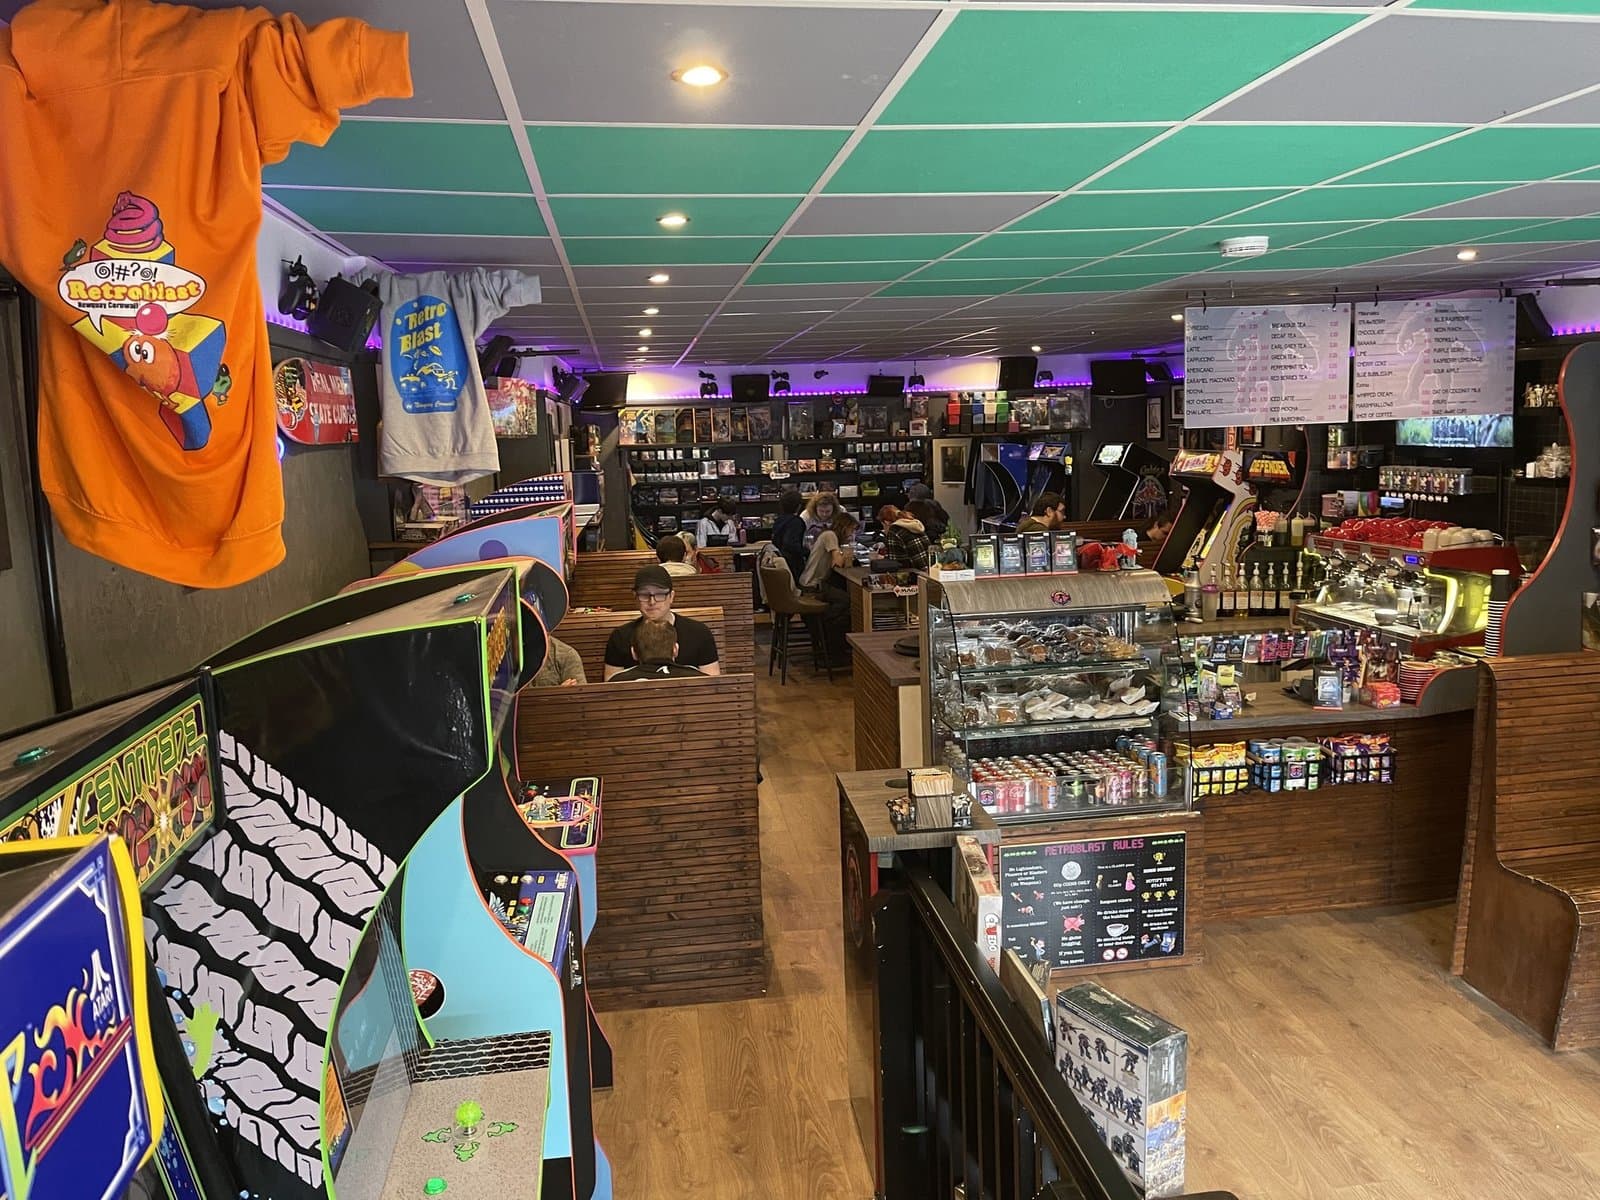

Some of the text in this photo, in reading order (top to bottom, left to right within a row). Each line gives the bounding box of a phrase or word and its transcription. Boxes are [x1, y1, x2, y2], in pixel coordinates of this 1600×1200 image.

[66, 280, 202, 301] Retroblast
[404, 302, 448, 330] Retro
[398, 321, 444, 356] Blast
[1248, 459, 1291, 476] DEFENDER
[79, 708, 207, 834] CENTIPEDE
[1045, 839, 1144, 857] RETROBLAST RULES
[92, 984, 115, 1021] ATARI
